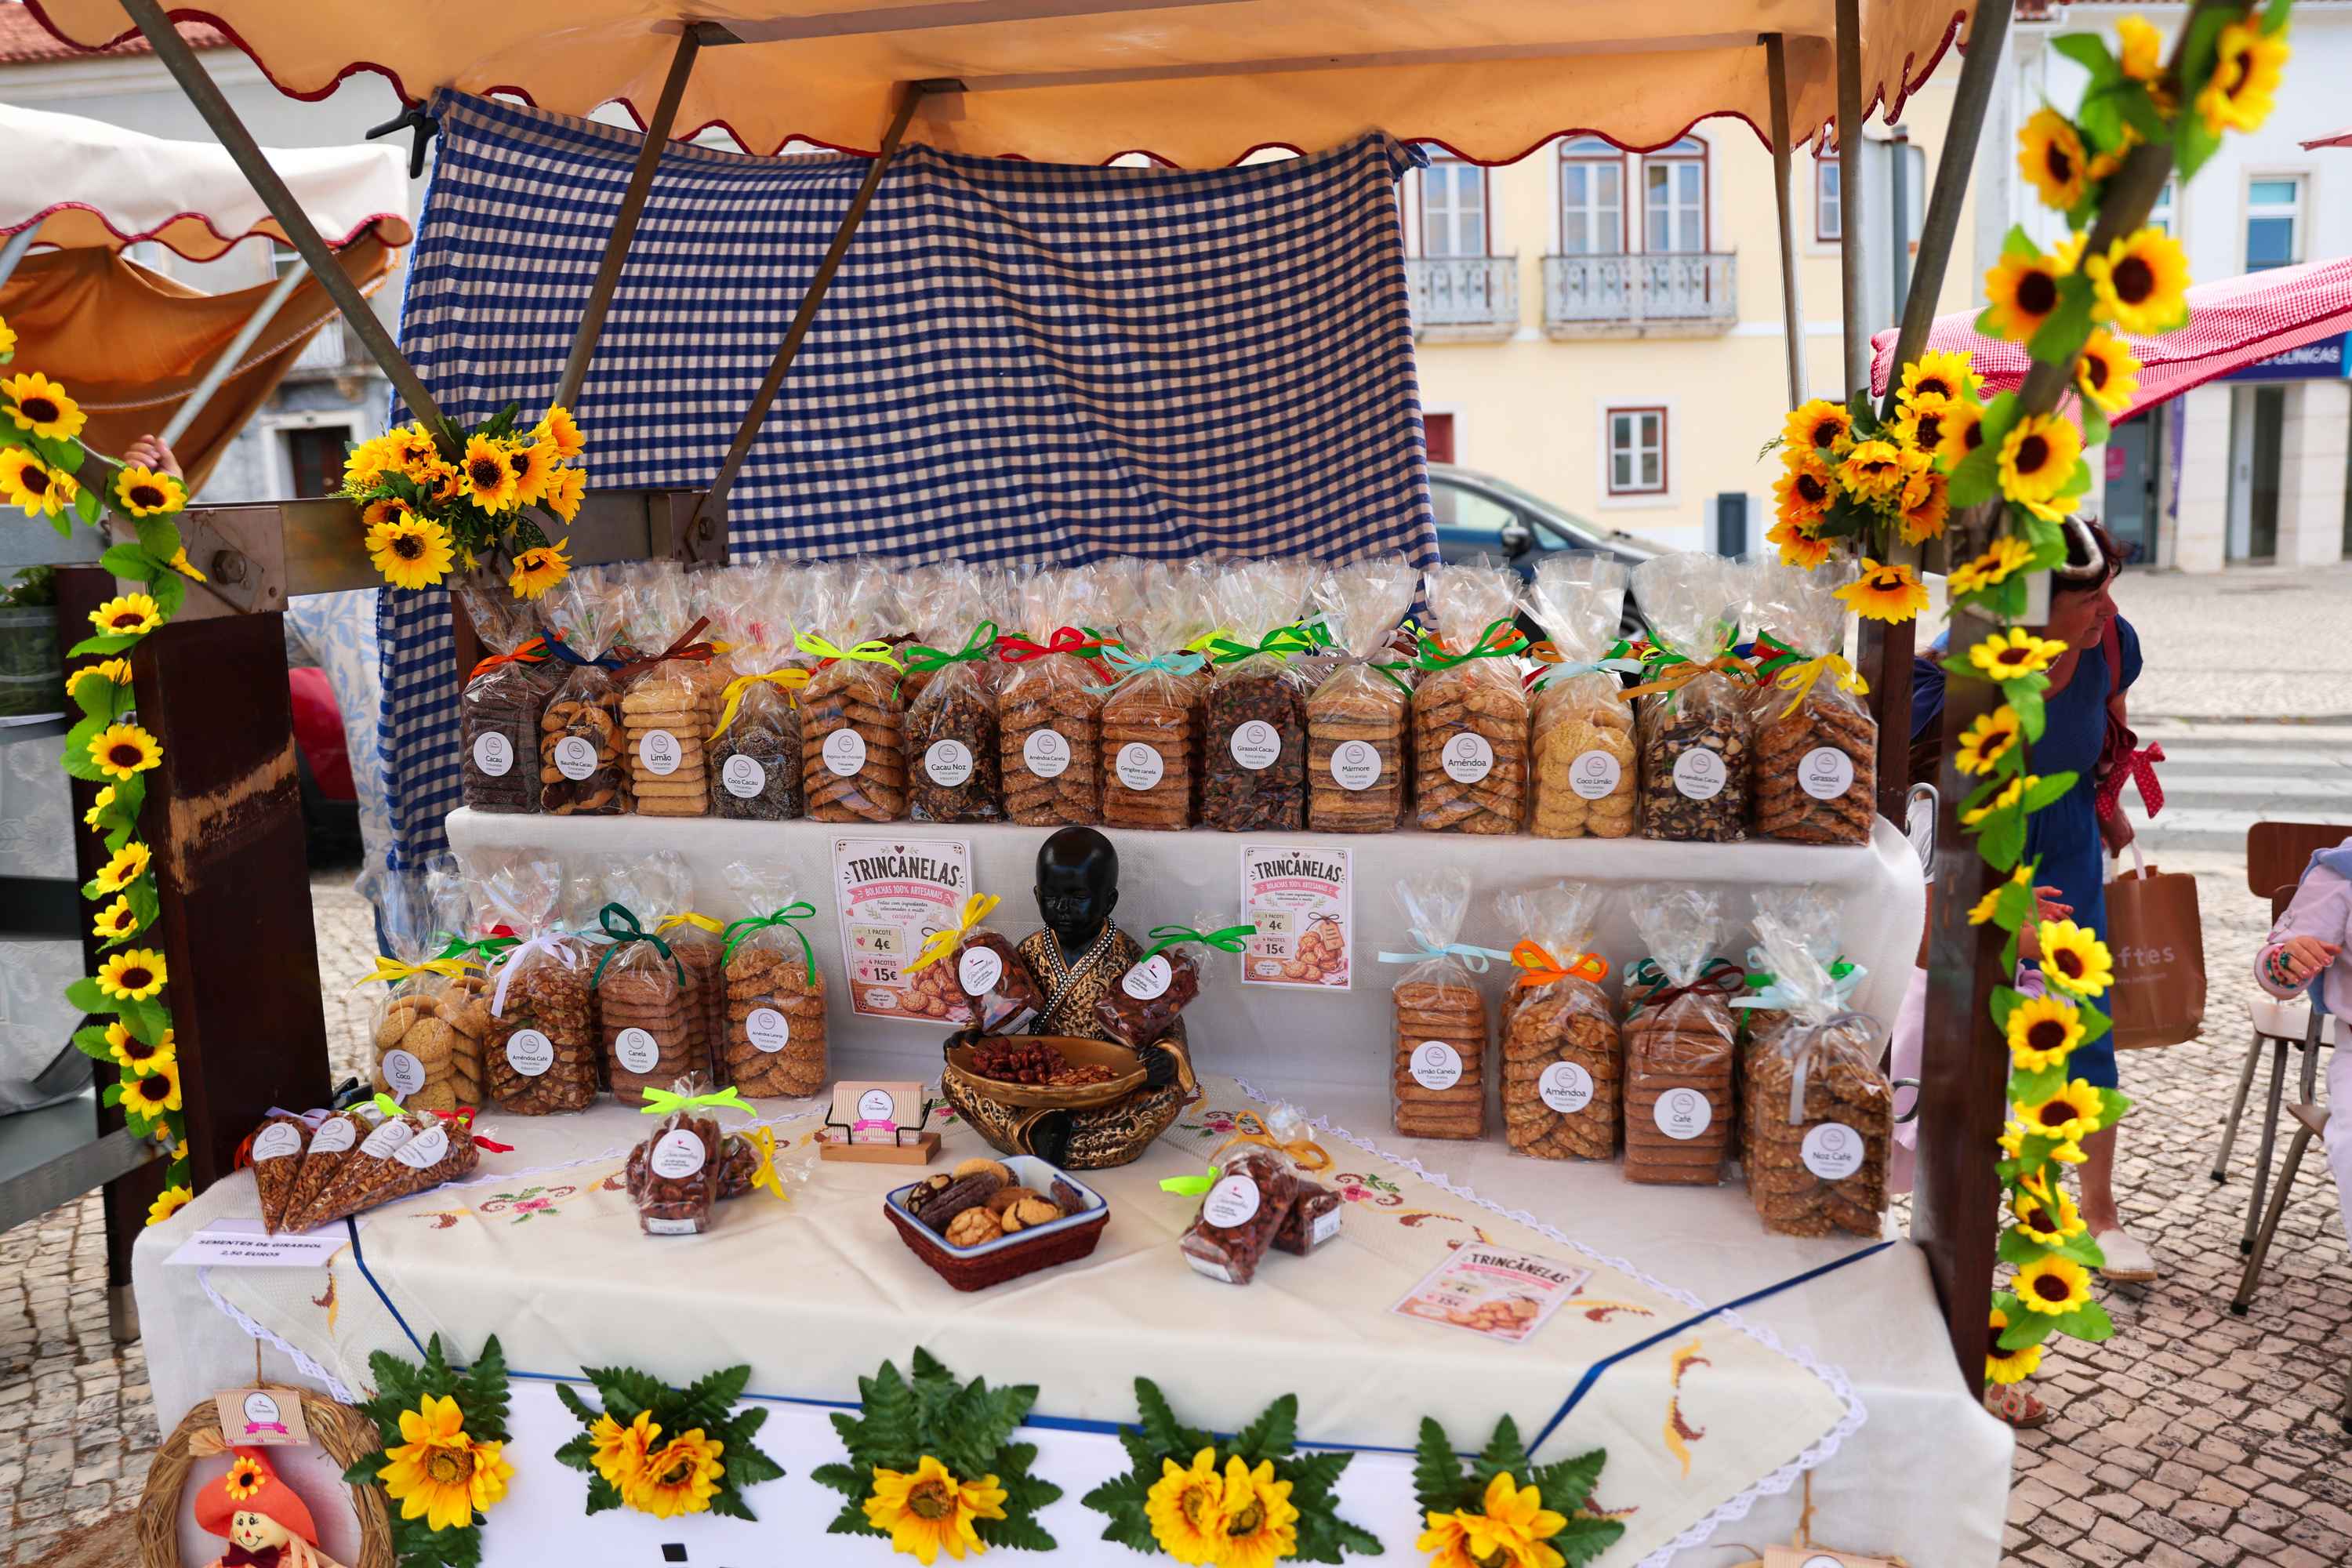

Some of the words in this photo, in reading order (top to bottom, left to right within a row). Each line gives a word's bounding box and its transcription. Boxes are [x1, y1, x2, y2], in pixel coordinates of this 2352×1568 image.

[1448, 758, 1486, 767] Amêndoa
[1809, 774, 1840, 783] Girassol
[848, 855, 960, 887] TRINCANELAS
[1254, 859, 1342, 882] TRINCANELAS
[865, 884, 892, 897] BOLACHAS
[910, 885, 944, 900] ARTESANAIS
[1269, 920, 1283, 931] 4€
[874, 938, 891, 950] 4€
[1266, 943, 1285, 955] 15€
[873, 967, 898, 982] 15€
[537, 1054, 549, 1062] Café
[395, 1072, 412, 1080] Coco
[1544, 1087, 1588, 1098] Amêndoa
[1672, 1113, 1693, 1123] Café
